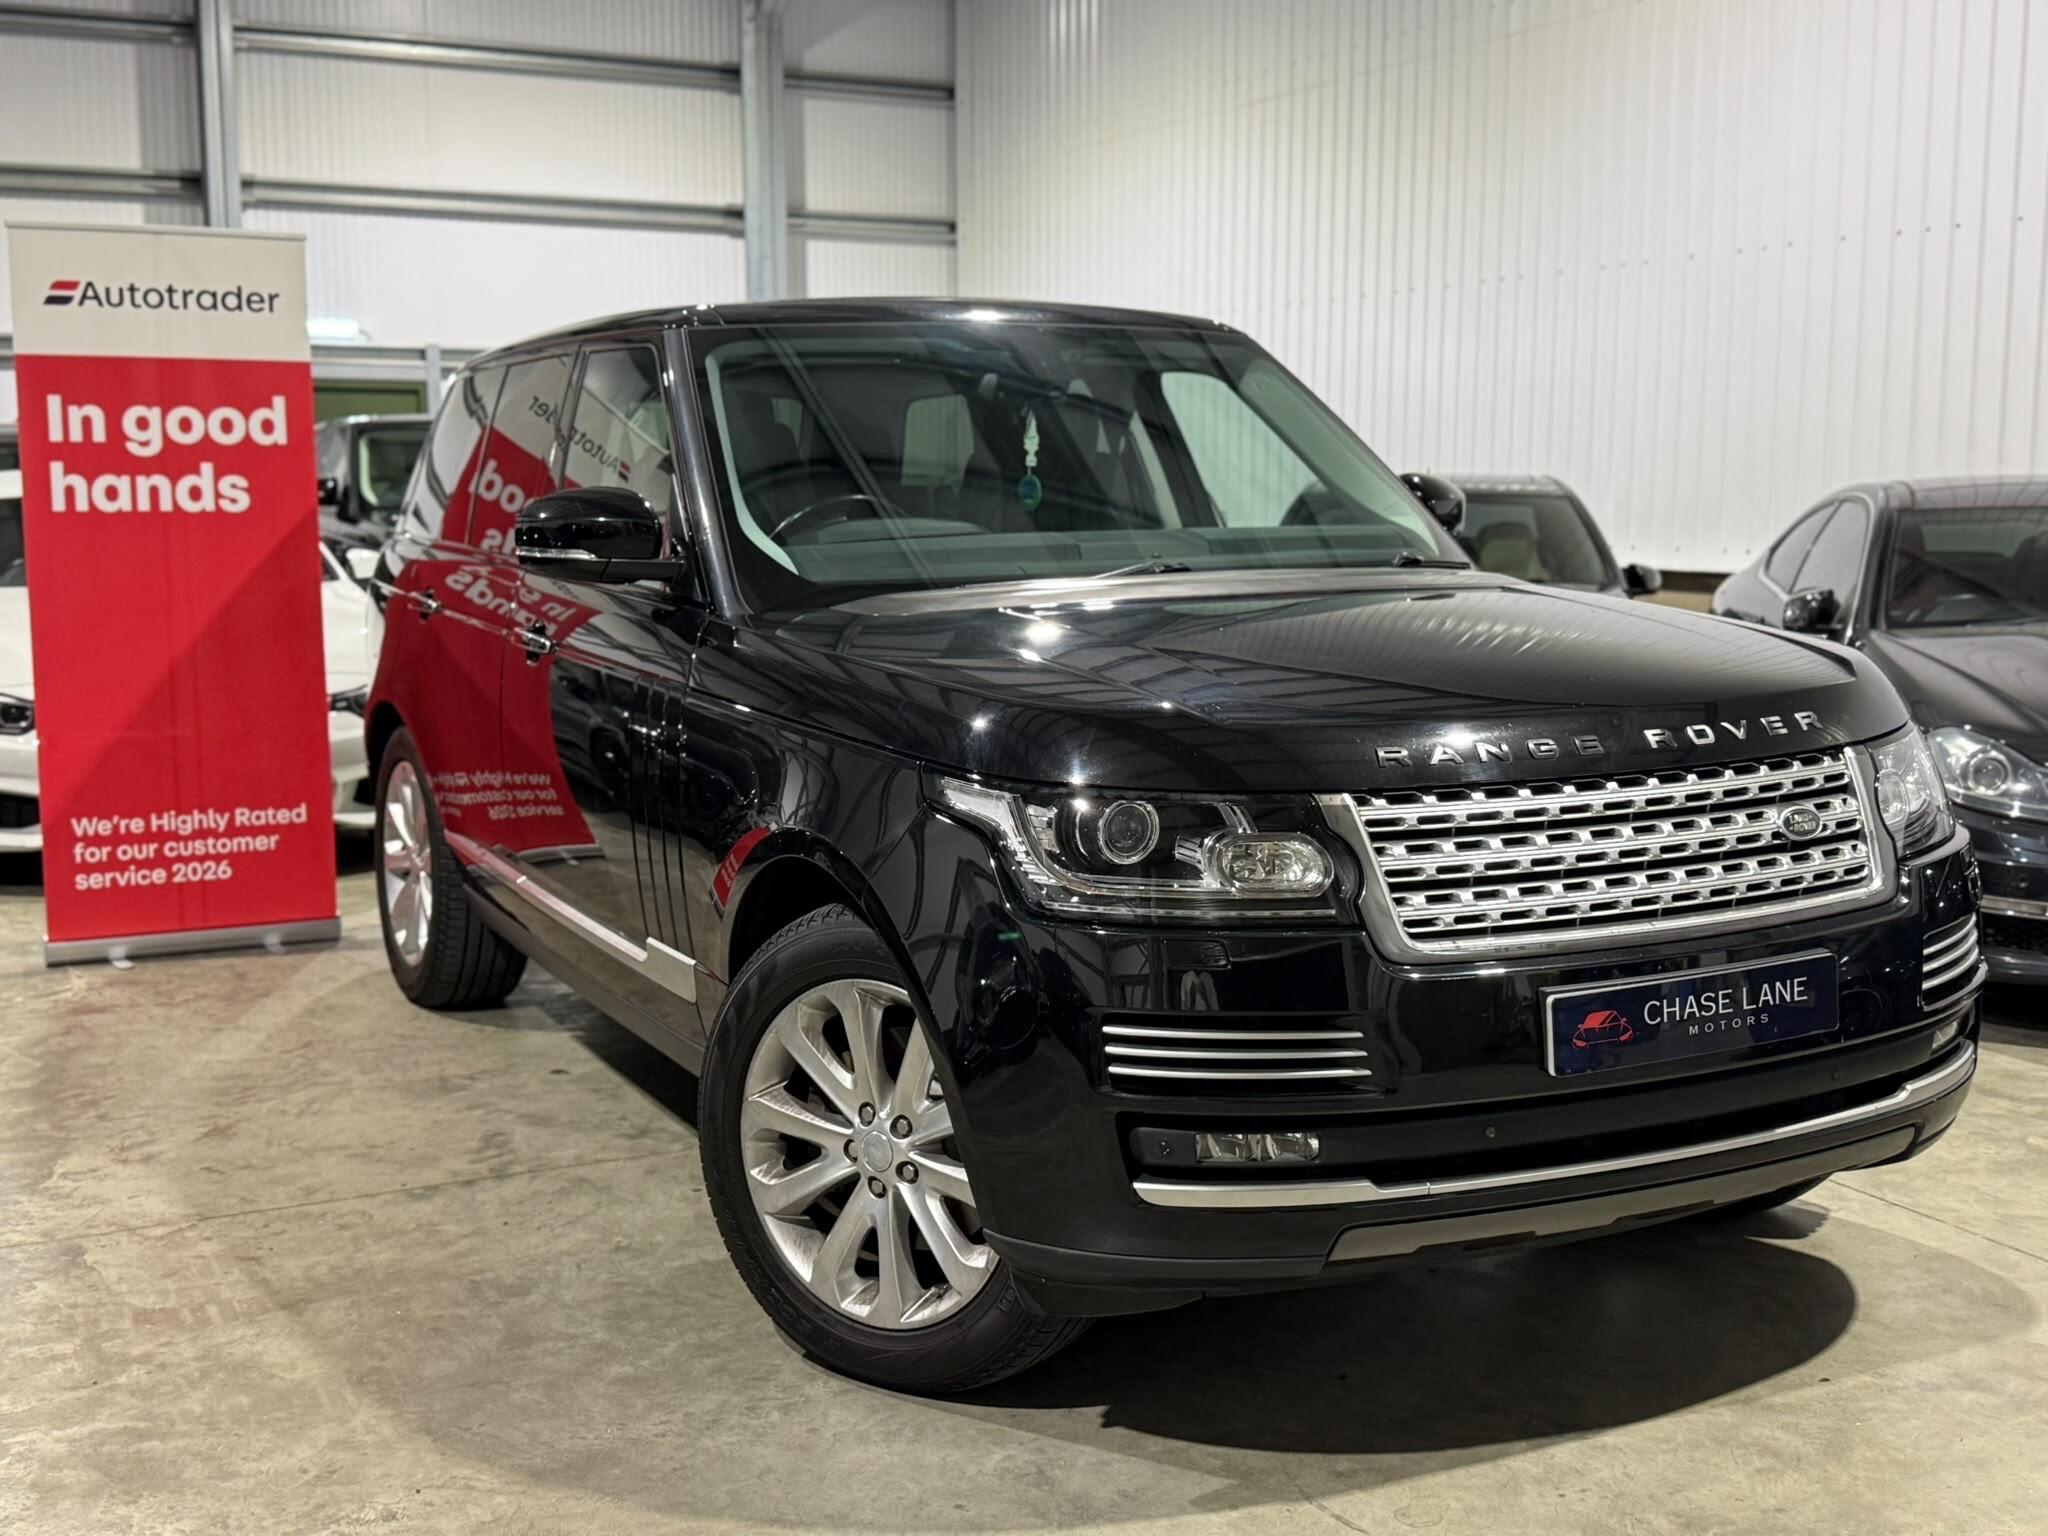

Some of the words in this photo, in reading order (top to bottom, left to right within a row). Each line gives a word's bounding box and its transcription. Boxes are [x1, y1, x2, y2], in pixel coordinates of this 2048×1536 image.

[78, 281, 280, 313] Autotrader
[47, 394, 107, 443] In
[122, 395, 288, 457] good
[49, 461, 251, 513] hands
[1376, 734, 1605, 768] RANGE
[1643, 711, 1823, 749] ROVER
[71, 815, 145, 837] We're
[150, 808, 229, 835] Highly
[235, 803, 307, 827] Rated
[74, 843, 112, 864] for
[116, 842, 158, 860] our
[163, 834, 279, 858] customer
[75, 866, 167, 890] service
[172, 860, 232, 883] 2026
[1644, 989, 1733, 1025] CHASE
[1742, 977, 1808, 1010] LANE
[1689, 1013, 1769, 1036] MOTORS
